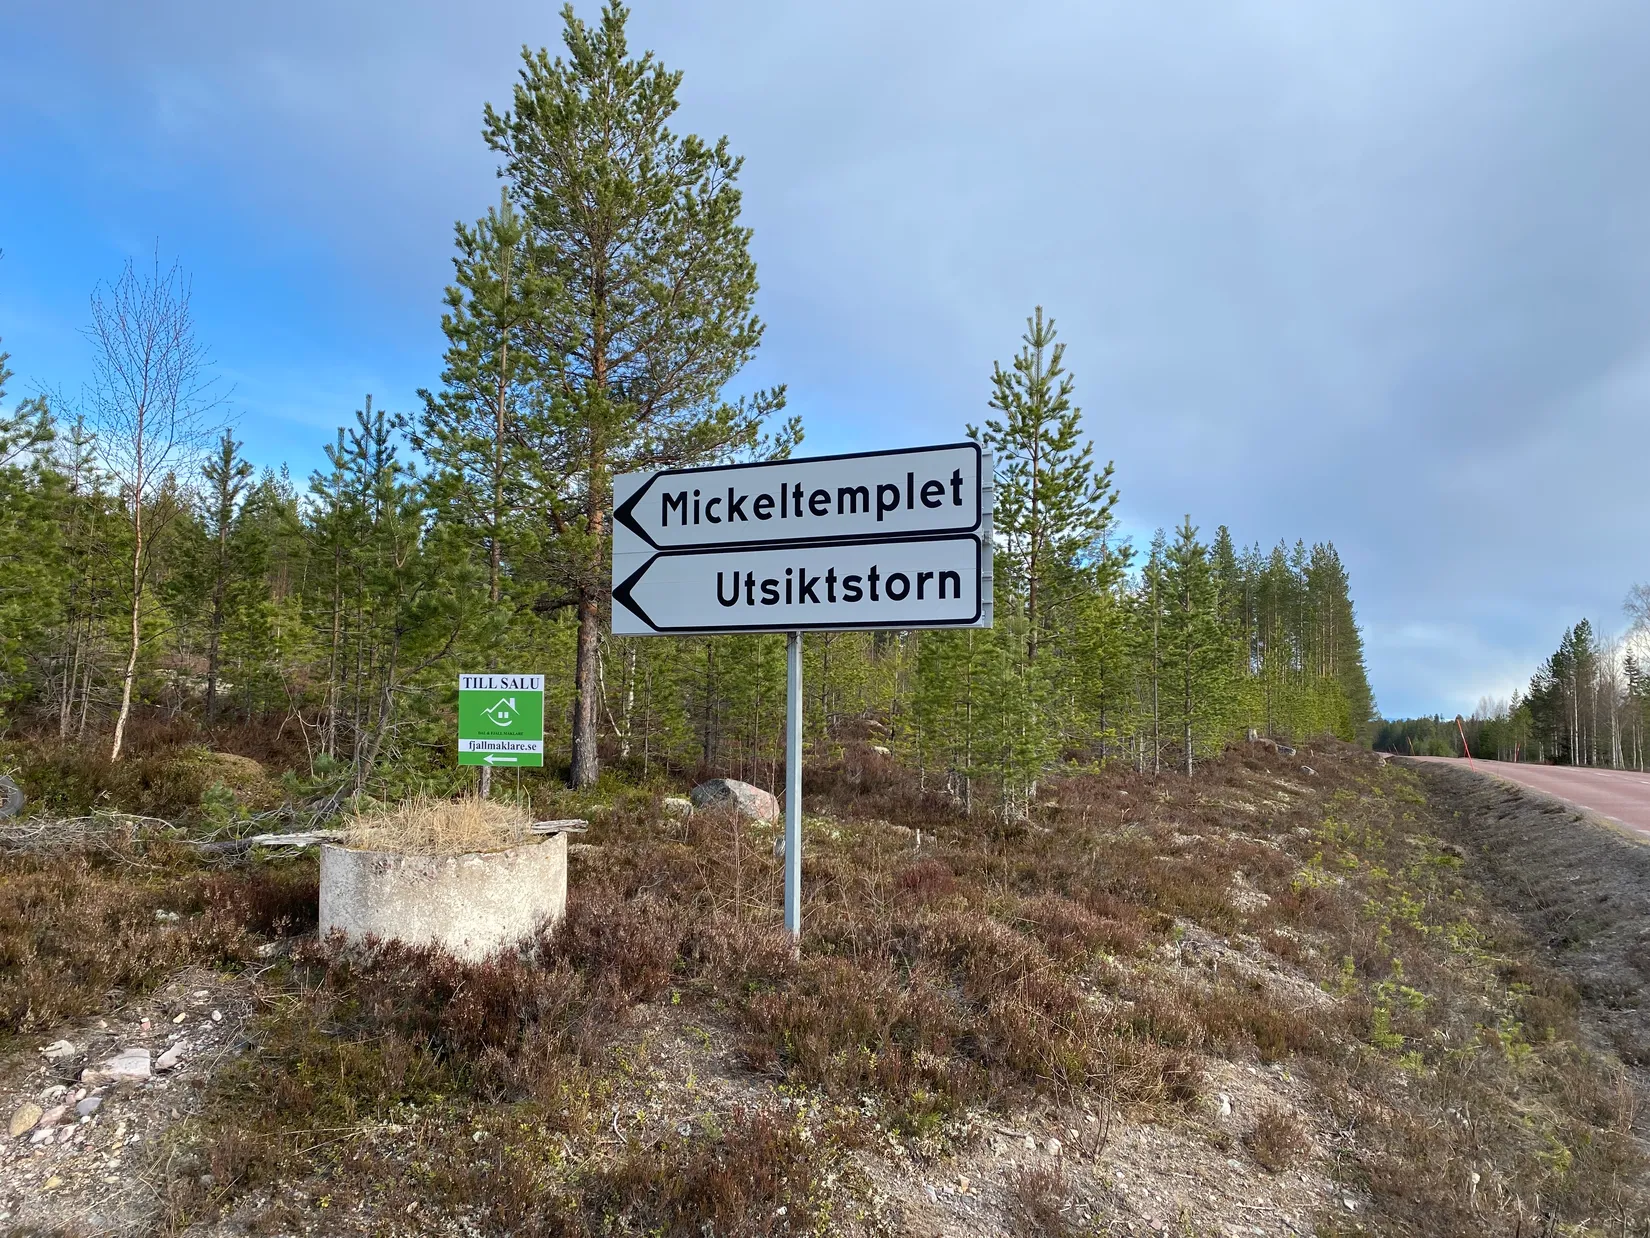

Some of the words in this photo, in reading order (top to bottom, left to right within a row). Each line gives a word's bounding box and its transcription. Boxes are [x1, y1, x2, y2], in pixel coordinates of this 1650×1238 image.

[661, 468, 963, 527] Mickeltemplet
[716, 565, 961, 607] Utsiktstorn
[463, 677, 497, 689] TILL
[501, 677, 540, 690] SALU
[469, 741, 537, 751] fjallmaklare.se
